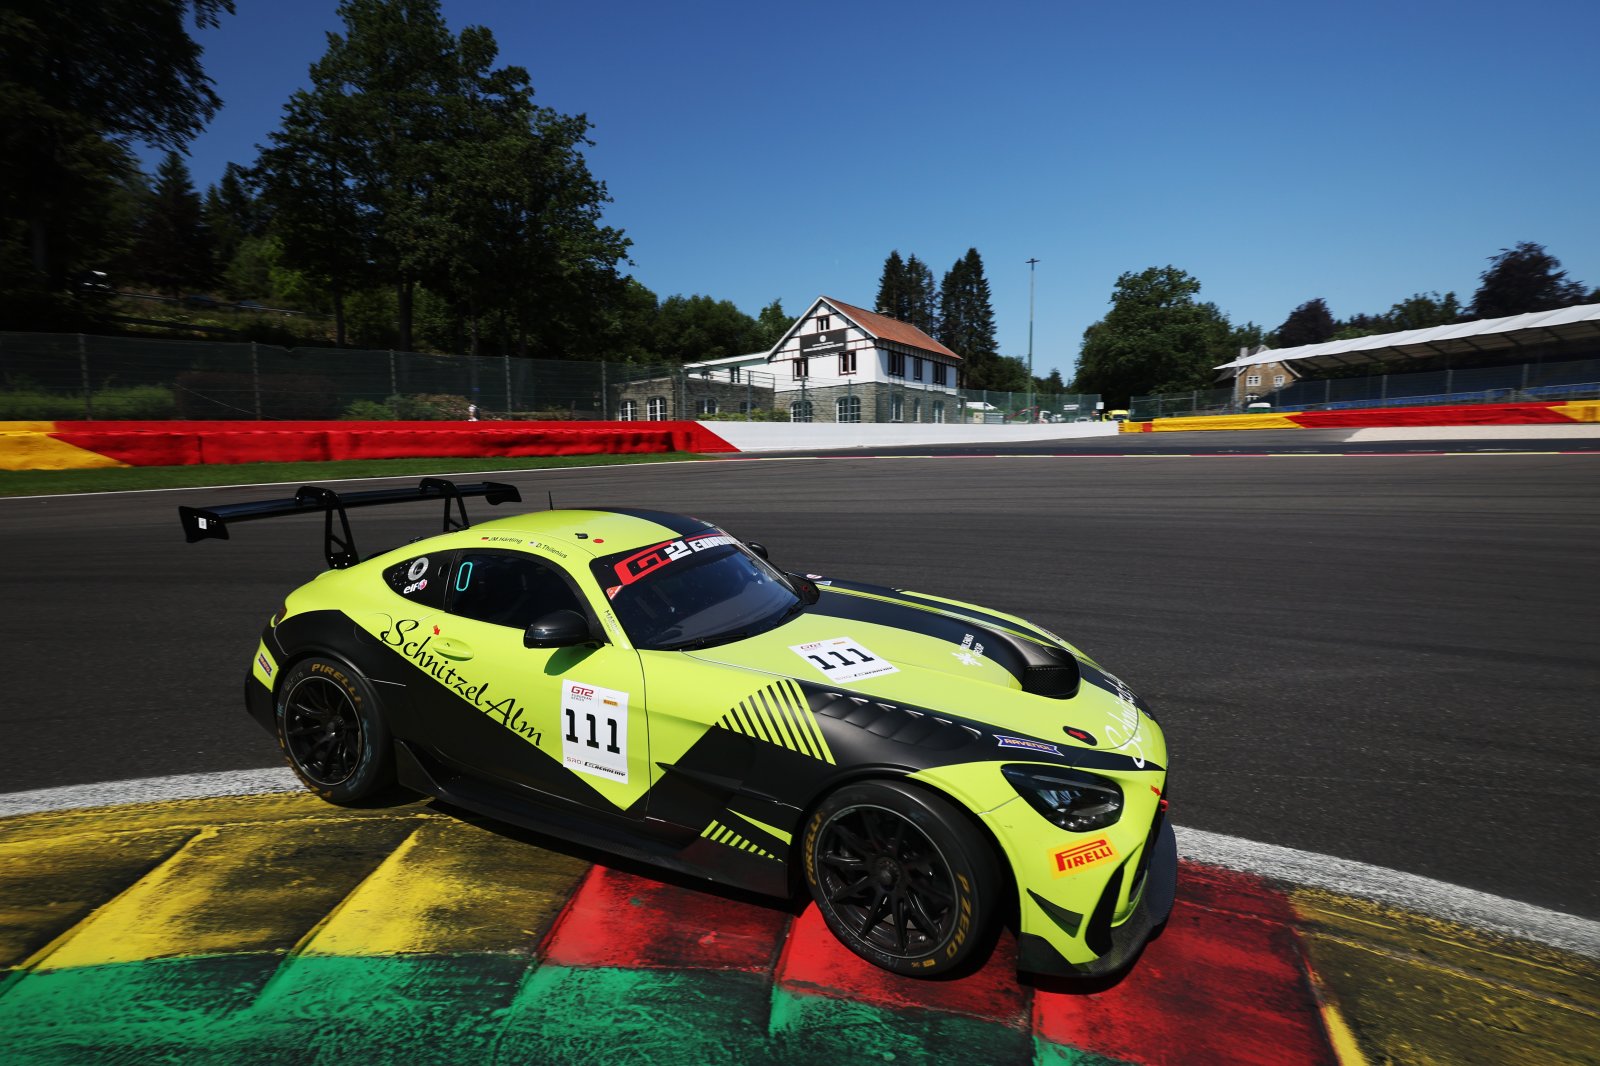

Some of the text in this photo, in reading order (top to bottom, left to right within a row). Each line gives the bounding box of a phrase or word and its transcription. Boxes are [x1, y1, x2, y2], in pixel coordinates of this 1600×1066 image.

[403, 582, 420, 595] elf
[807, 647, 875, 670] 111
[311, 663, 362, 704] PIRELLI
[571, 685, 594, 697] GT2
[565, 707, 620, 755] 111
[805, 811, 823, 886] PIRELLI
[1055, 839, 1113, 872] PIRELLI
[946, 896, 972, 960] ZERO
